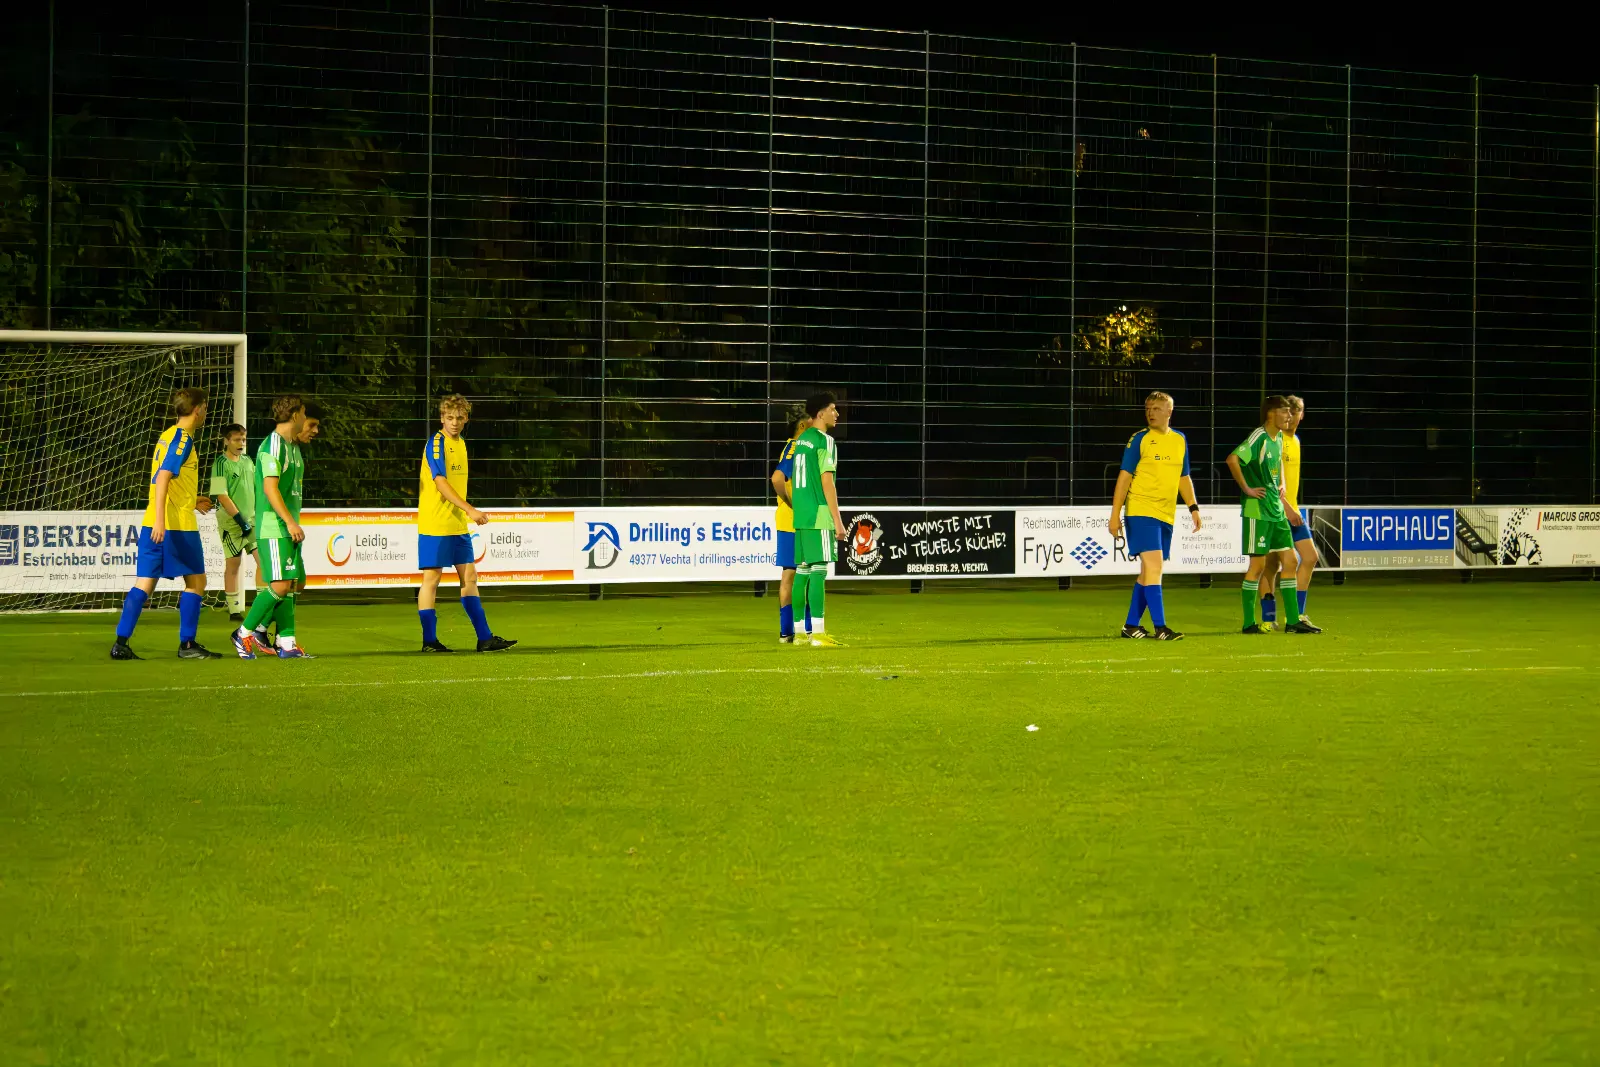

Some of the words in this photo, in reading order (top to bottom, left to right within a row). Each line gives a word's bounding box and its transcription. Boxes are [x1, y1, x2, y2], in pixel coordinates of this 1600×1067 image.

[795, 453, 806, 489] 11
[1023, 517, 1084, 530] Rechtsanwälte,
[1542, 511, 1576, 522] MARCUS
[711, 522, 771, 542] Estrich
[902, 516, 960, 537] KOMMSTE
[964, 515, 992, 530] MIT
[1346, 515, 1450, 541] TRIPHAUS
[23, 525, 139, 547] BERISHA
[355, 534, 388, 549] Leidig
[490, 532, 522, 547] Leidig
[889, 543, 907, 560] IN
[911, 538, 962, 557] TEUFELS
[965, 532, 1007, 551] KÜCHE?
[23, 552, 96, 566] Estrichbau
[355, 551, 373, 561] Maler
[374, 551, 379, 561] &
[380, 551, 407, 561] Lackierer
[490, 549, 507, 559] Maler
[508, 549, 513, 558] &
[514, 549, 540, 558] Lackierer
[629, 553, 657, 565] 49377
[659, 553, 691, 565] Vechta
[1023, 537, 1064, 571] Frye
[1181, 554, 1246, 566] www.frye-radau.de
[1346, 556, 1377, 566] METALL
[1380, 556, 1389, 565] IN
[1392, 556, 1414, 564] FORM
[907, 563, 934, 573] BREMER
[935, 563, 949, 573] STR.
[950, 563, 960, 574] 29,
[961, 562, 988, 572] VECHTA
